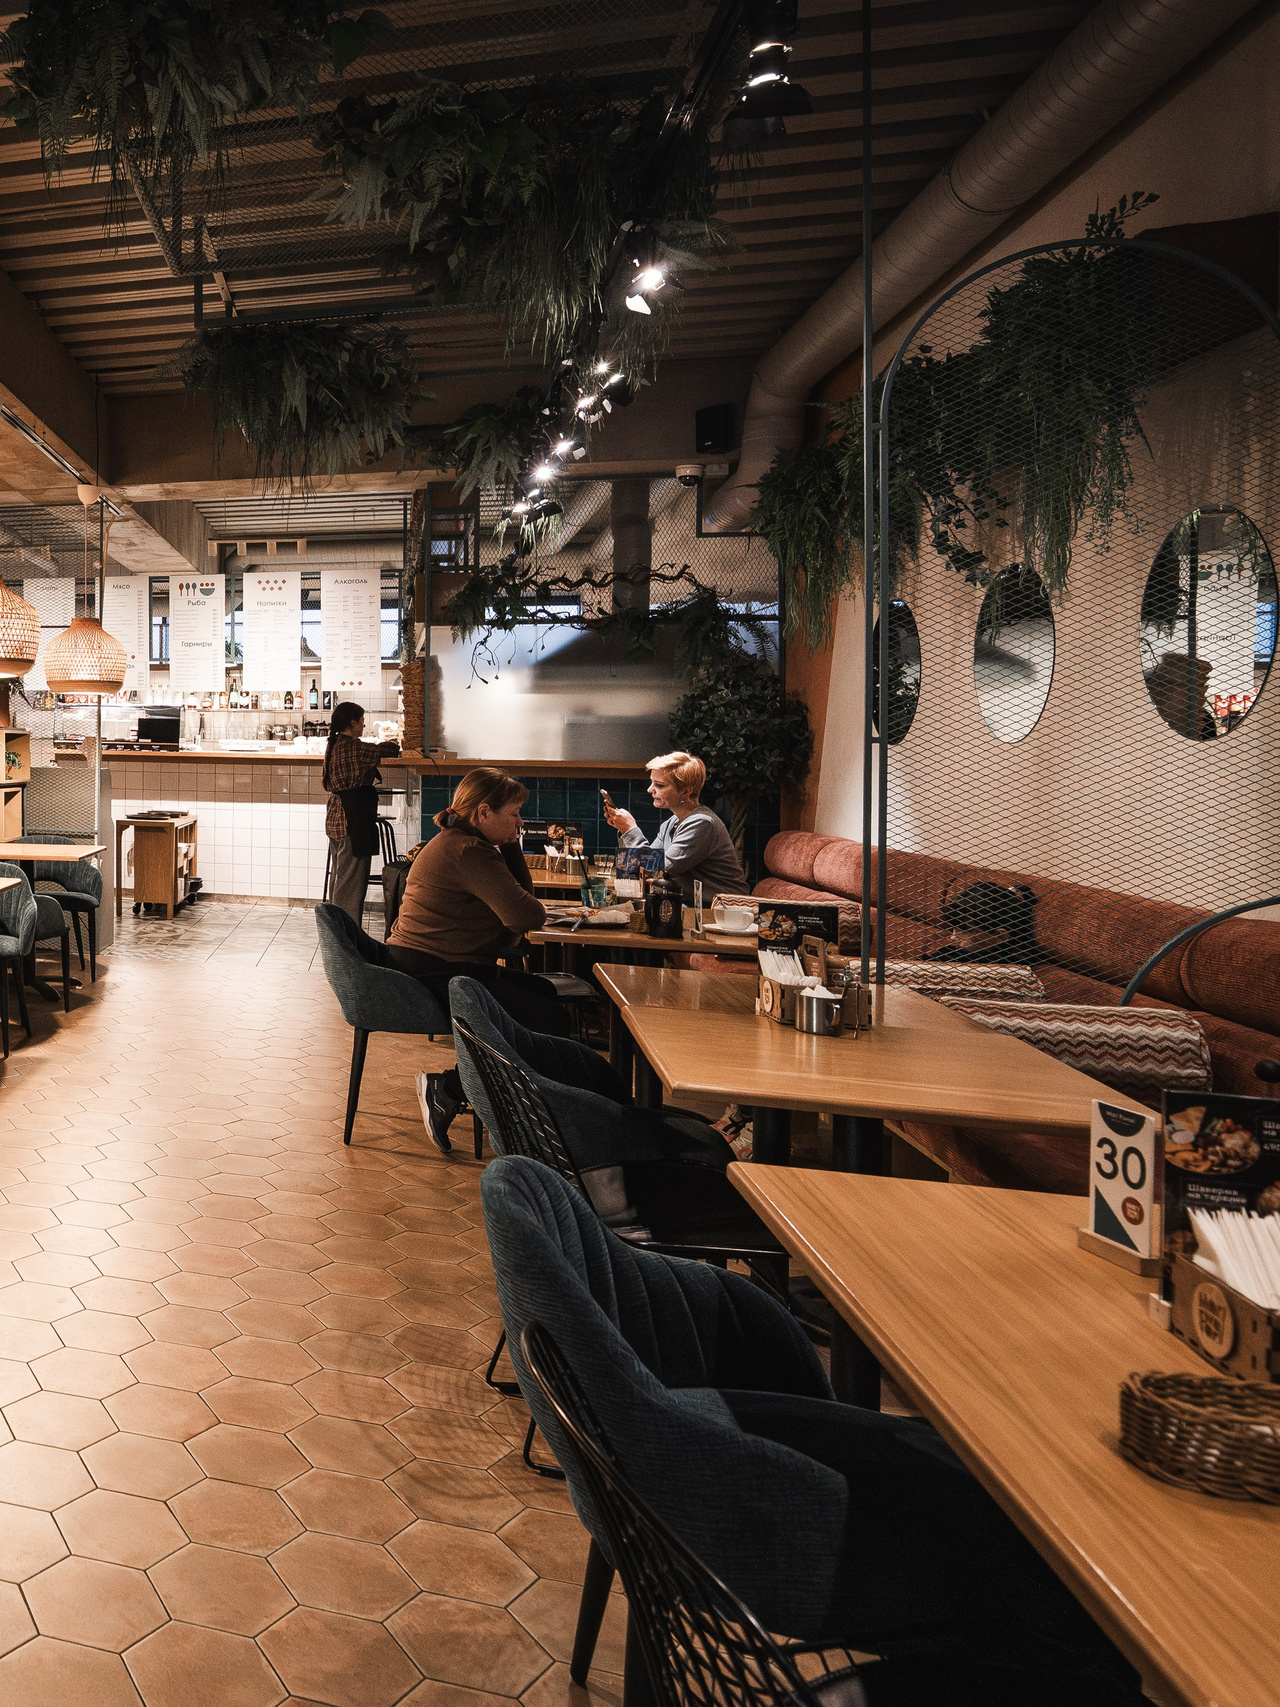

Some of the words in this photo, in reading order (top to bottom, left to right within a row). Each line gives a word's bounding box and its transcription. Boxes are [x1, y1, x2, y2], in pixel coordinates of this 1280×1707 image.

[181, 641, 213, 649] Гарниры
[1095, 1137, 1146, 1190] 30
[1187, 1184, 1239, 1196] Шаверма
